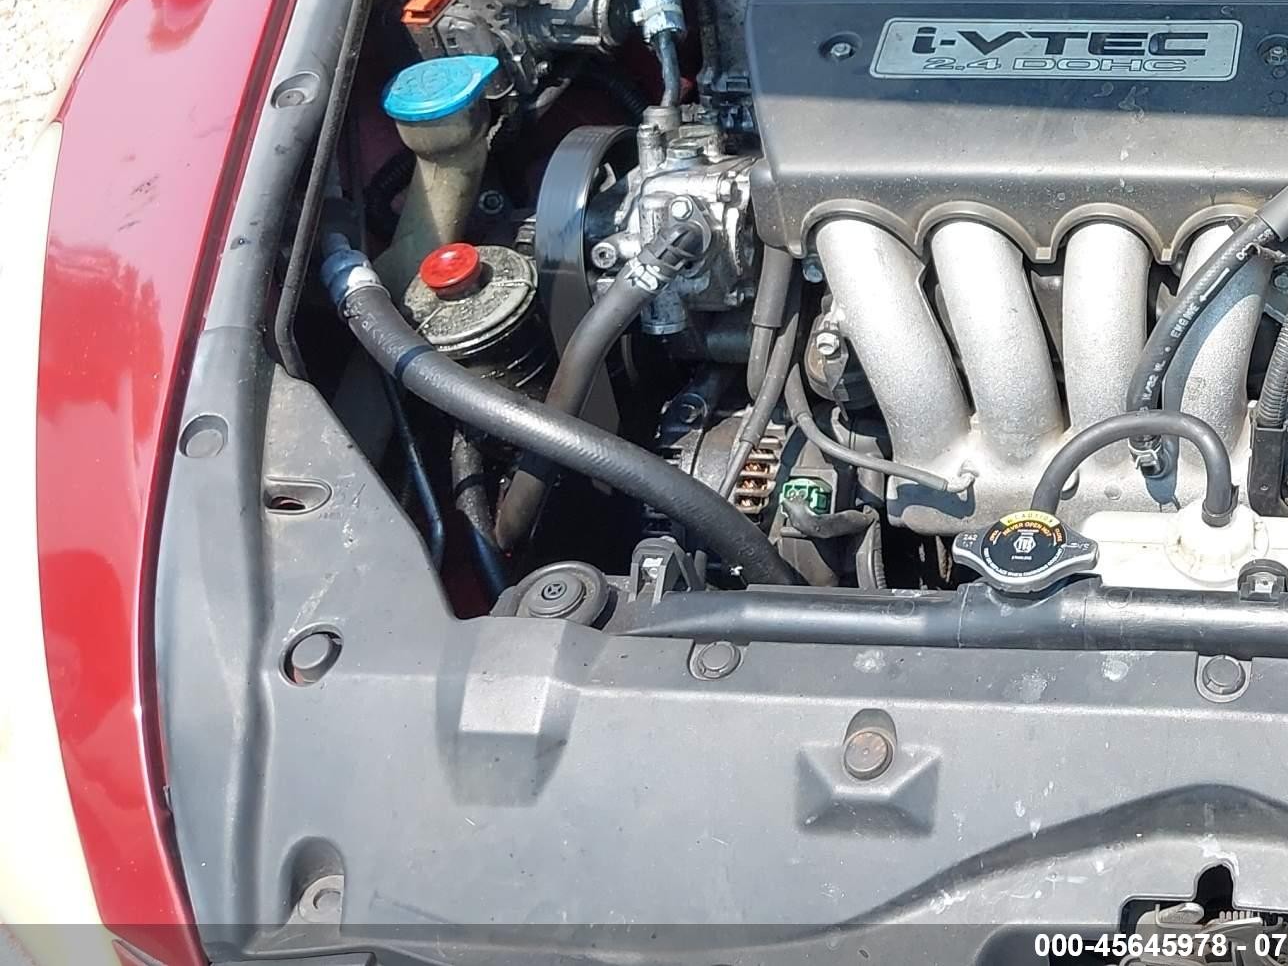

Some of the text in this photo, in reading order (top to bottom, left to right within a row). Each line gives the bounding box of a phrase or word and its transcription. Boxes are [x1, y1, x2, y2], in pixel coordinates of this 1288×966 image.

[911, 26, 1210, 57] i-VTEC
[923, 56, 1188, 72] 2.4 DOHC
[1002, 522, 1024, 537] NEVER
[1024, 521, 1042, 531] OPEN
[1041, 525, 1052, 538] HOT
